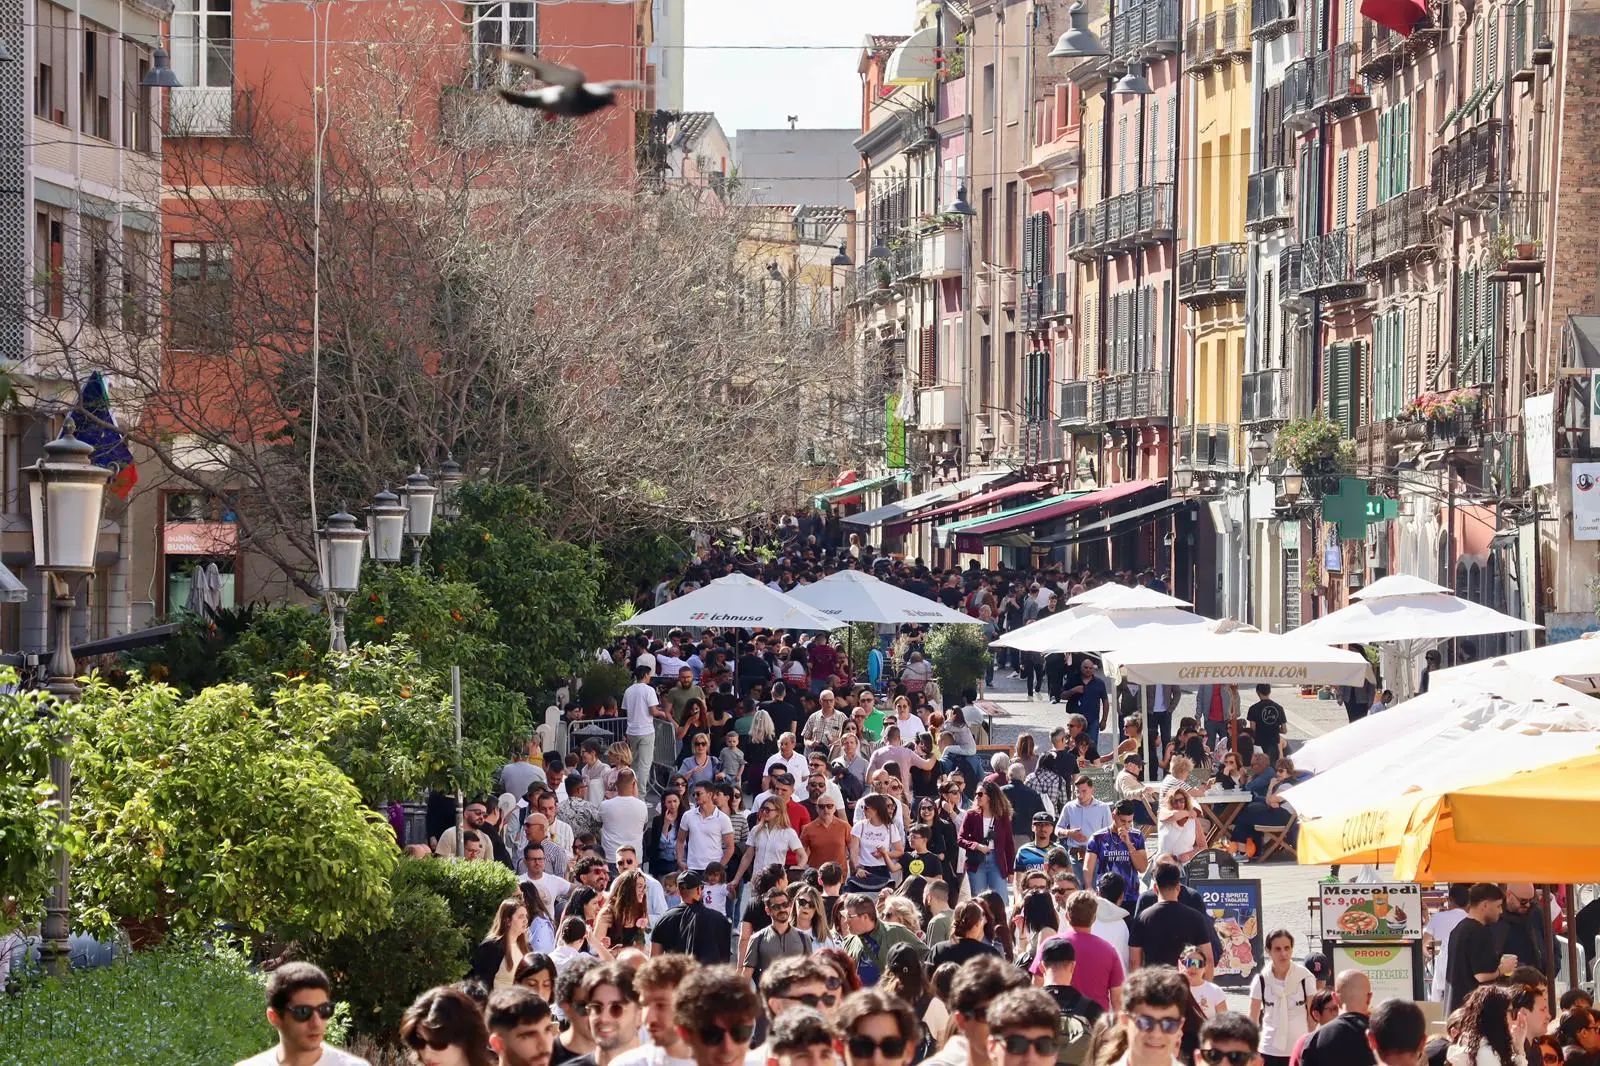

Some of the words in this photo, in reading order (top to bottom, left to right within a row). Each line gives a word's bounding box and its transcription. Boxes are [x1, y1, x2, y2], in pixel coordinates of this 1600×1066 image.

[1178, 666, 1308, 679] CAFFECONTINI.COM
[1324, 884, 1418, 895] Mercoledì
[1203, 892, 1220, 903] 20
[1354, 950, 1391, 958] PROMO
